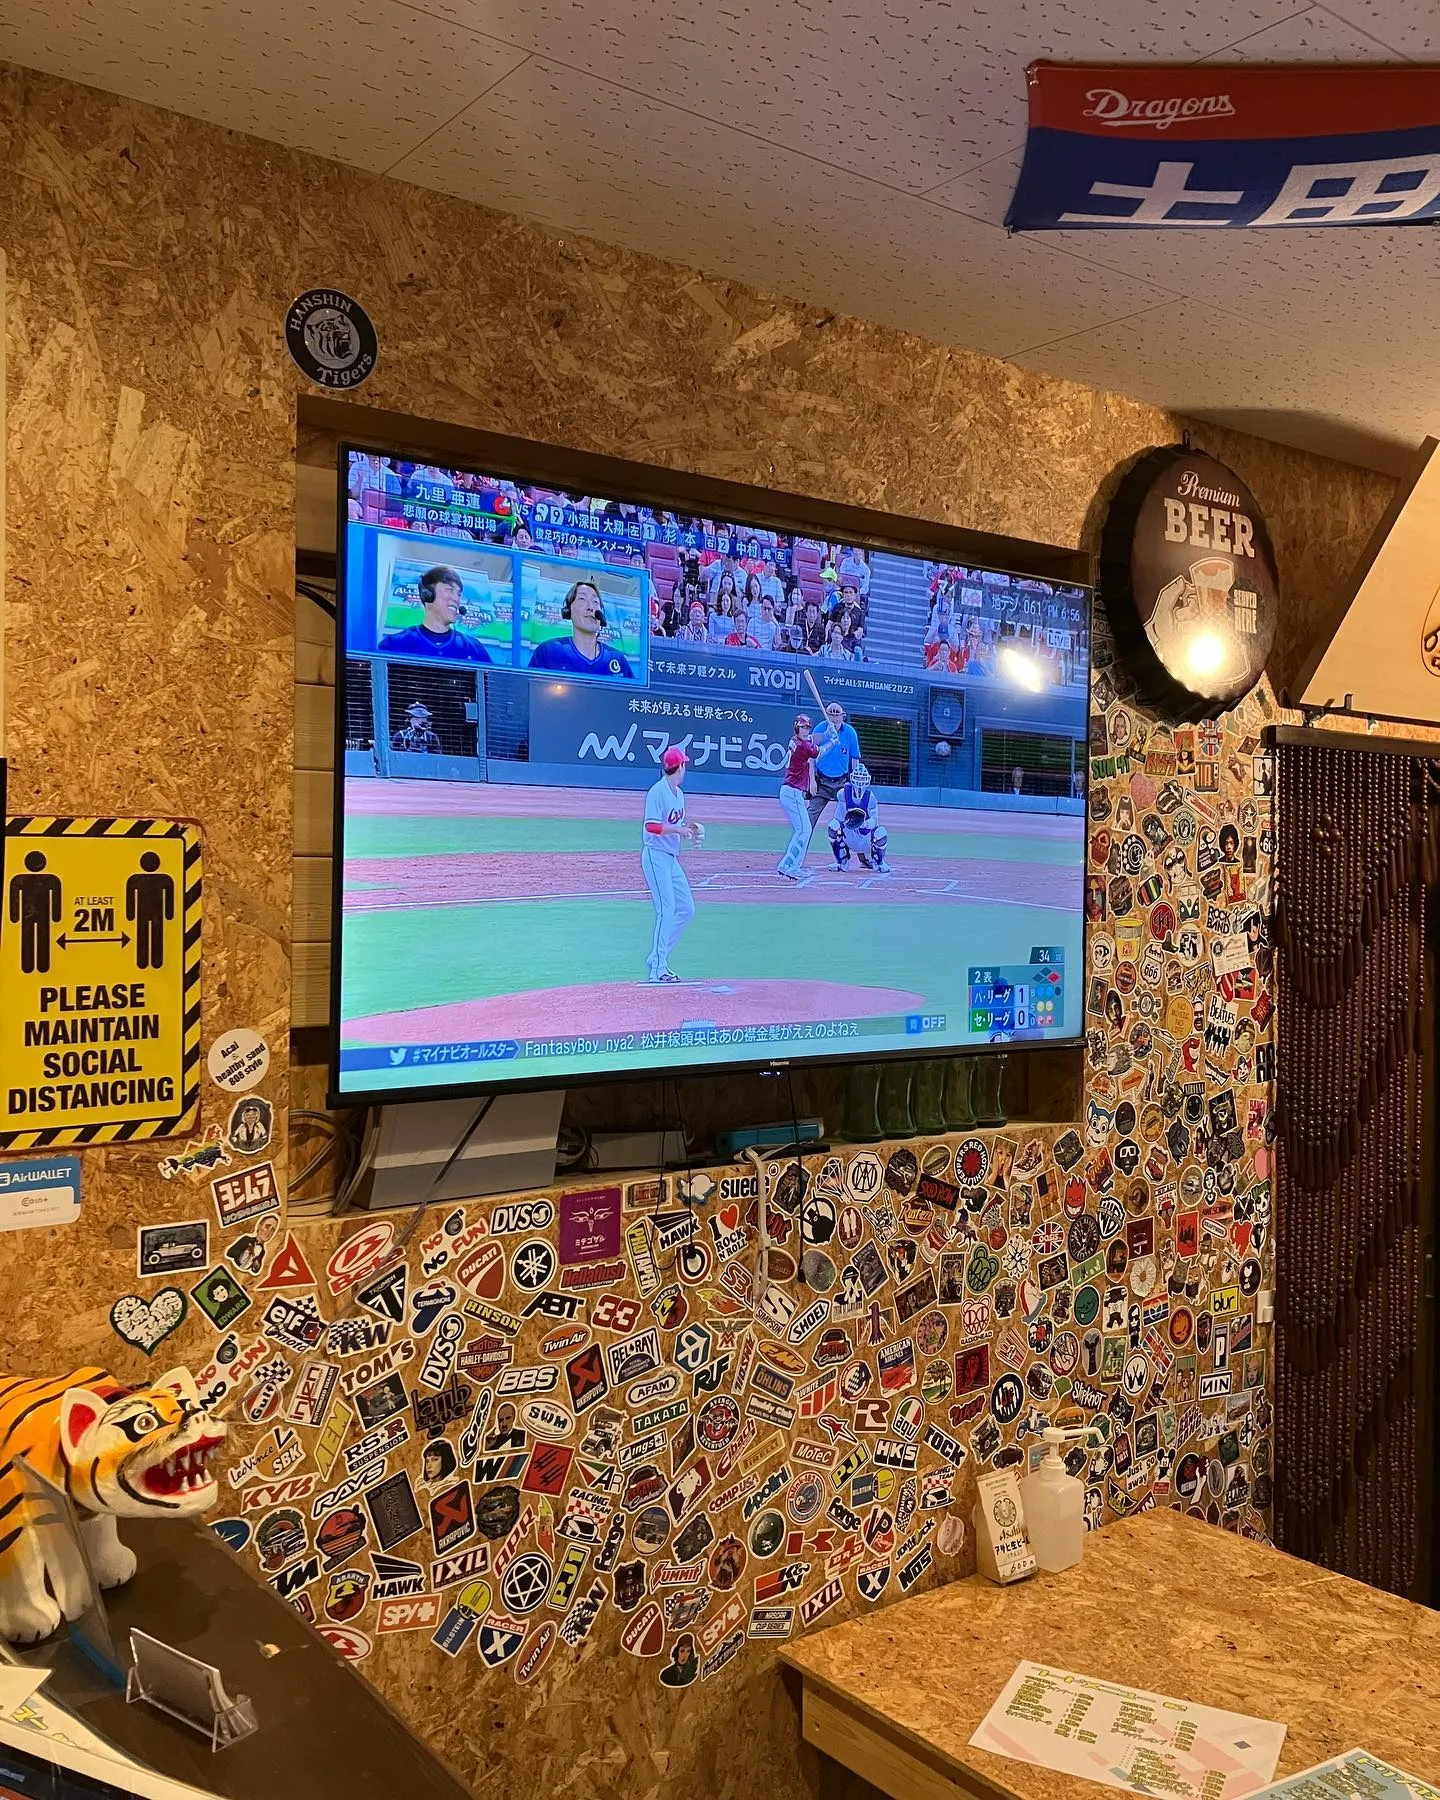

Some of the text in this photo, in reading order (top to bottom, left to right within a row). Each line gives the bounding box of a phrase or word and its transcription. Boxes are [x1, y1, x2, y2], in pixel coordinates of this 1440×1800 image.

[1083, 88, 1236, 130] Dragons
[290, 293, 352, 331] HANSHIN
[317, 353, 372, 385] Tigers
[415, 484, 481, 510] 九里 亜蓮
[1177, 470, 1241, 508] Premium
[402, 503, 497, 532] 悲願の球宴初出場
[567, 511, 600, 532] 小深田
[1164, 497, 1255, 558] BEER
[534, 527, 641, 555] 俊足巧打のチャンスメーカー
[1023, 600, 1041, 616] 061
[1061, 608, 1080, 622] 6:56
[749, 666, 800, 690] RYOBI
[1091, 755, 1130, 780] SUM 41
[75, 896, 113, 906] AT LEAST
[1208, 905, 1229, 921] ROCK
[74, 909, 114, 933] 2M
[1207, 919, 1229, 935] BAND
[1039, 950, 1050, 962] 34
[40, 983, 145, 1012] PLEASE
[24, 1014, 159, 1046] MAINTAIN
[922, 1016, 945, 1029] OFF
[974, 1010, 1012, 1027] セ・リーグ
[413, 1034, 634, 1063] #マイナビオールスター FantasyBoy_nya2
[43, 1048, 142, 1078] SOCIAL
[216, 1043, 266, 1083] healthy sand
[228, 1058, 263, 1086] 808 style
[8, 1077, 174, 1115] DISTANCING
[494, 1204, 532, 1233] DVS
[422, 1233, 443, 1251] NO
[660, 1219, 700, 1247] HAWK
[716, 1228, 746, 1249] ROCK
[423, 1223, 487, 1274] NO FUN
[726, 1239, 747, 1257] ROLL
[461, 1247, 498, 1279] DUCATI
[217, 1299, 247, 1326] EDWARD
[466, 1300, 521, 1331] HINSON
[592, 1294, 641, 1333] 33
[1213, 1294, 1235, 1312] blur
[270, 1306, 305, 1331] elf
[756, 1309, 783, 1337] SIMPSON
[794, 1303, 826, 1339] SHOEI
[544, 1331, 587, 1354] Twin Air
[880, 1339, 911, 1358] AMERICAN
[961, 1331, 992, 1346] RADIOHEAD
[421, 1340, 455, 1387] DVS
[459, 1350, 509, 1366] HARLEY-DAVIDSON
[499, 1367, 559, 1394] BBS
[637, 1380, 671, 1398] AFAM
[251, 1382, 275, 1420] Gulf
[709, 1397, 735, 1410] AVENGED
[528, 1406, 568, 1430] SWM
[635, 1402, 687, 1430] TAKATA
[272, 1443, 303, 1475] SBK
[796, 1444, 832, 1463] MoTeC
[876, 1439, 916, 1460] HKS
[939, 1472, 955, 1480] TEAM
[1127, 1464, 1142, 1478] Just
[1146, 1456, 1155, 1469] go
[1127, 1474, 1148, 1490] away
[570, 1489, 608, 1506] RACING
[591, 1504, 611, 1515] TEAM
[435, 1550, 486, 1583] IXIL
[860, 1561, 889, 1574] RACER
[336, 1576, 365, 1584] ABARTH
[372, 1577, 424, 1599] HAWK
[866, 1570, 882, 1594] X
[804, 1580, 842, 1621] IXIL
[486, 1619, 524, 1632] RACER
[625, 1606, 655, 1645] DUCATI
[484, 1630, 514, 1658] X
[520, 1628, 551, 1678] Twin Air
